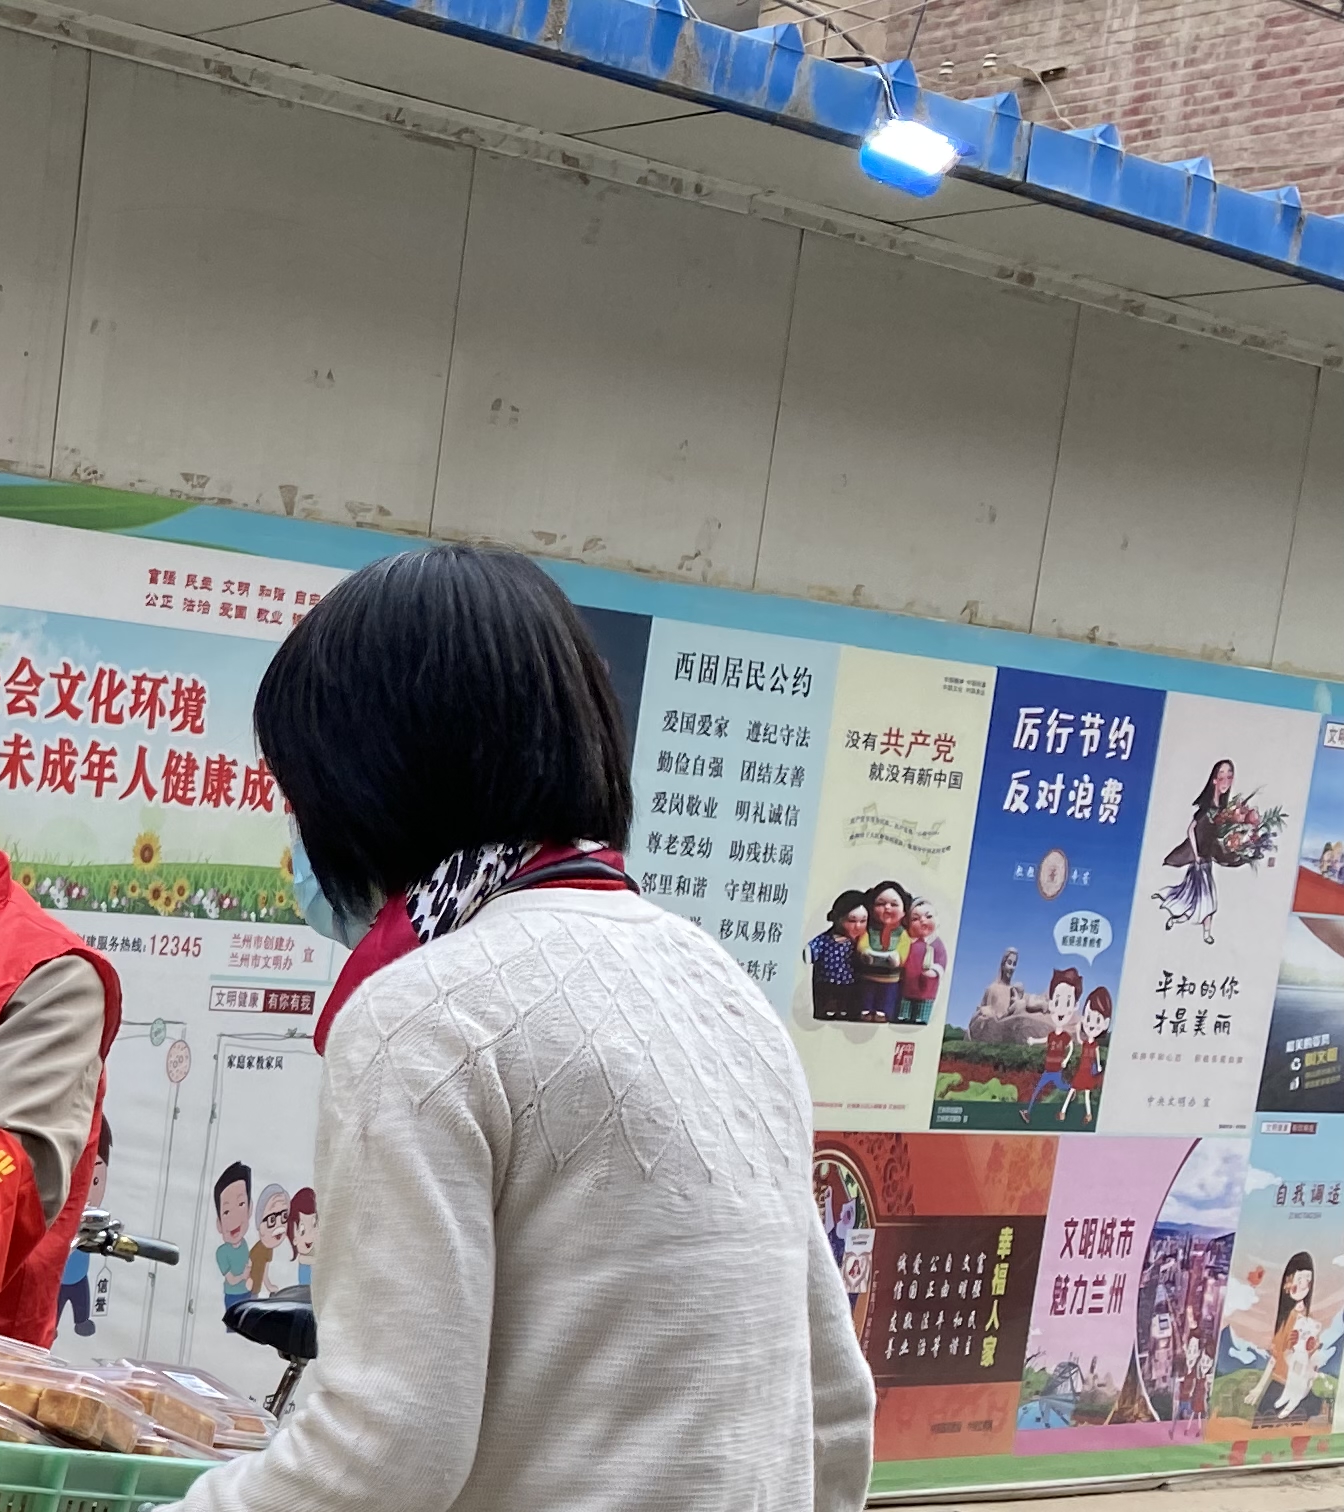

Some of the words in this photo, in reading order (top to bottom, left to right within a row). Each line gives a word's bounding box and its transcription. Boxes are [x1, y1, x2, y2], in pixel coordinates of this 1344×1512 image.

[184, 573, 213, 592] 民主
[221, 579, 251, 598] 文明
[258, 584, 286, 602] 和谐
[144, 592, 174, 610] 公正
[182, 597, 211, 615] 法治
[218, 602, 248, 620] 爱国
[256, 607, 283, 625] 敬业
[674, 650, 814, 699] 西固居民公约
[661, 709, 730, 740] 爱国爱家
[746, 719, 813, 750] 遵纪守法
[844, 725, 957, 764] 没有共产党
[1012, 705, 1136, 762] 厉行节约
[657, 749, 725, 780] 勤俭自强
[739, 759, 806, 789] 团结友善
[868, 761, 964, 790] 就没有新中国
[651, 790, 719, 822] 爱岗敬业
[734, 799, 801, 829] 明礼诚信
[1002, 769, 1125, 825] 反对浪费
[646, 831, 714, 861] 尊老爱幼
[728, 839, 795, 869] 助残扶弱
[641, 871, 708, 900] 邻里和谐
[723, 879, 789, 906] 守望相助
[77, 932, 148, 953] 建服务热线:
[149, 934, 203, 958] 12345
[229, 933, 296, 952] 兰州市创建办
[718, 918, 784, 944] 移风易俗
[228, 951, 294, 970] 兰州市文明办
[736, 957, 779, 982] 秩序
[214, 989, 259, 1008] 文明健康
[1154, 970, 1240, 1000] 平和的你
[1152, 1008, 1232, 1037] 才最美丽
[227, 1054, 284, 1071] 家庭家教家风
[1059, 1217, 1137, 1260] 文明城市
[979, 1226, 1014, 1367] 幸福人家
[1049, 1273, 1126, 1317] 魅力兰州
